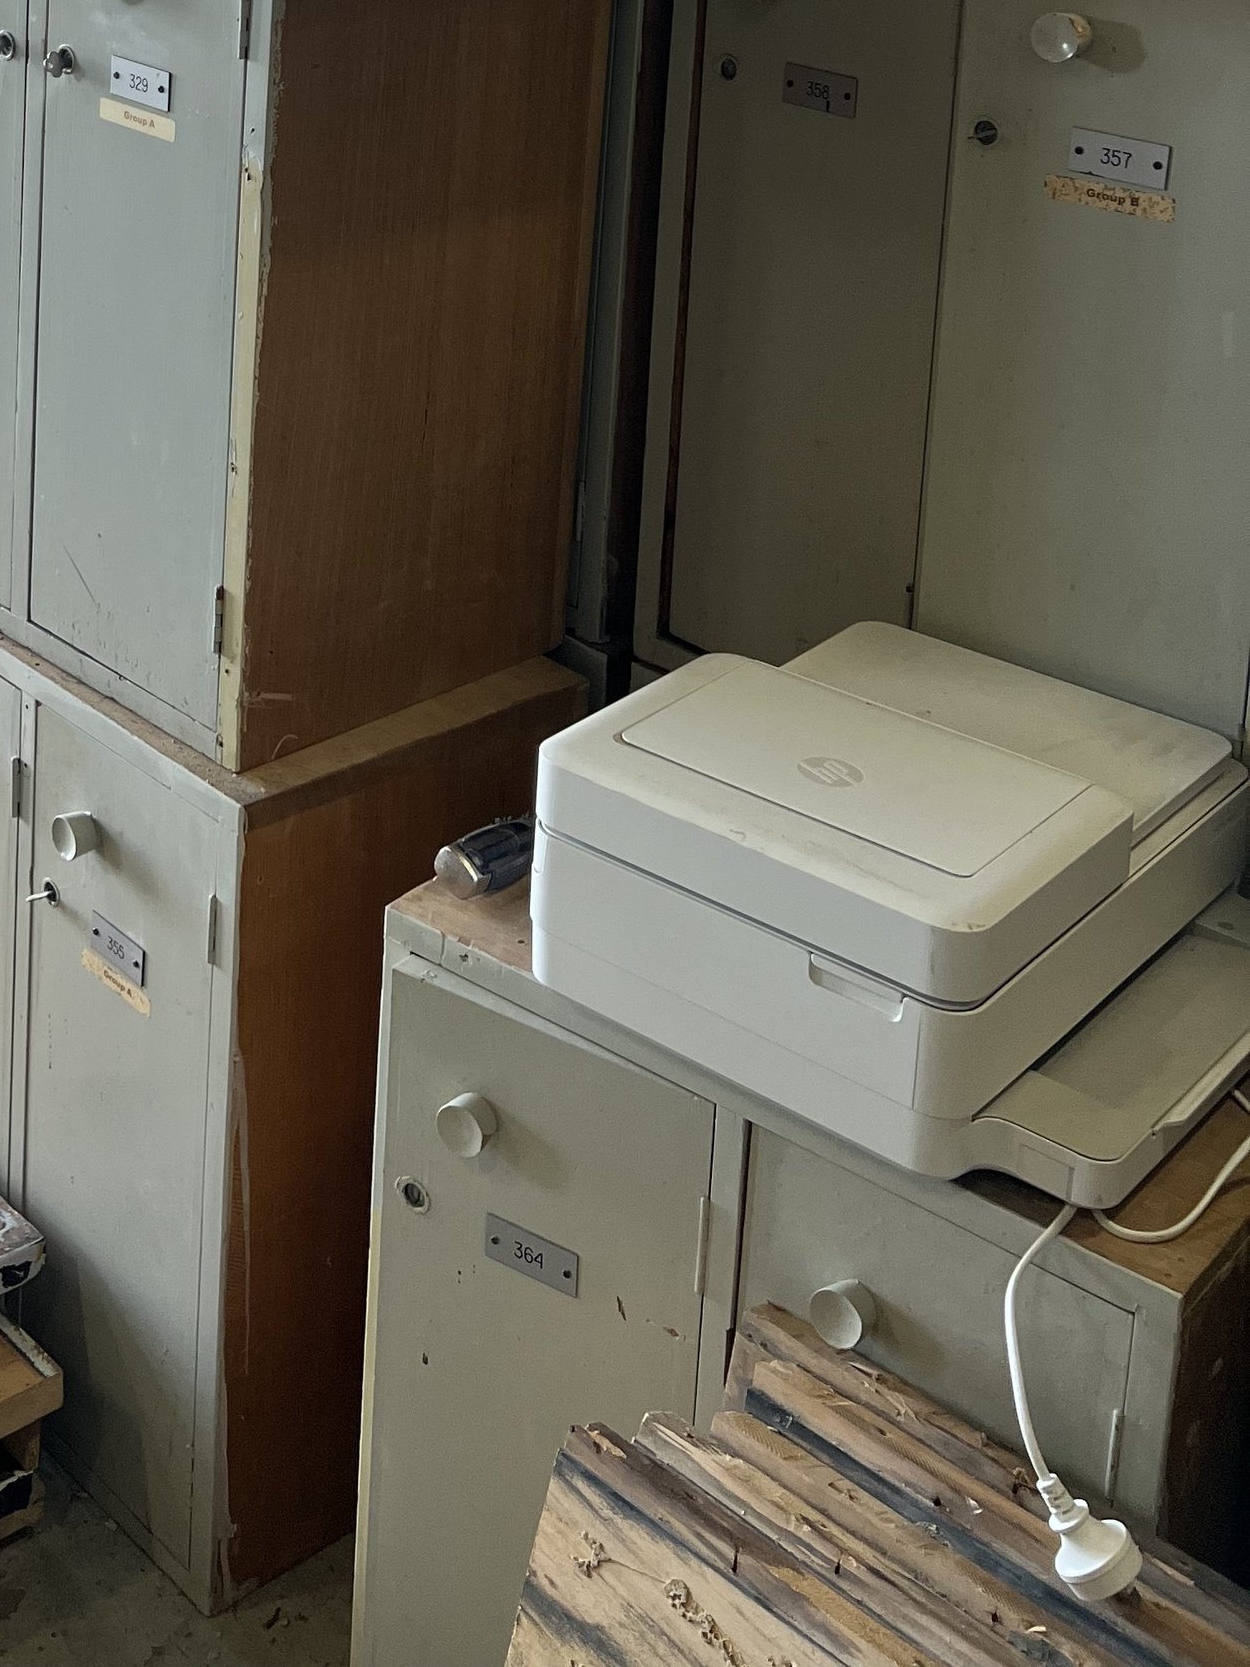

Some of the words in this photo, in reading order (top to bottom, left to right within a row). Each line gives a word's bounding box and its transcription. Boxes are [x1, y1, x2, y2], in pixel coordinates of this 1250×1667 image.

[130, 74, 148, 92] 329
[806, 80, 830, 101] 358
[123, 110, 148, 127] Group
[148, 119, 156, 128] A
[1100, 148, 1131, 168] 357
[1086, 187, 1127, 207] Group
[107, 936, 124, 959] 355
[103, 969, 126, 993] Group
[514, 1242, 544, 1270] 364
